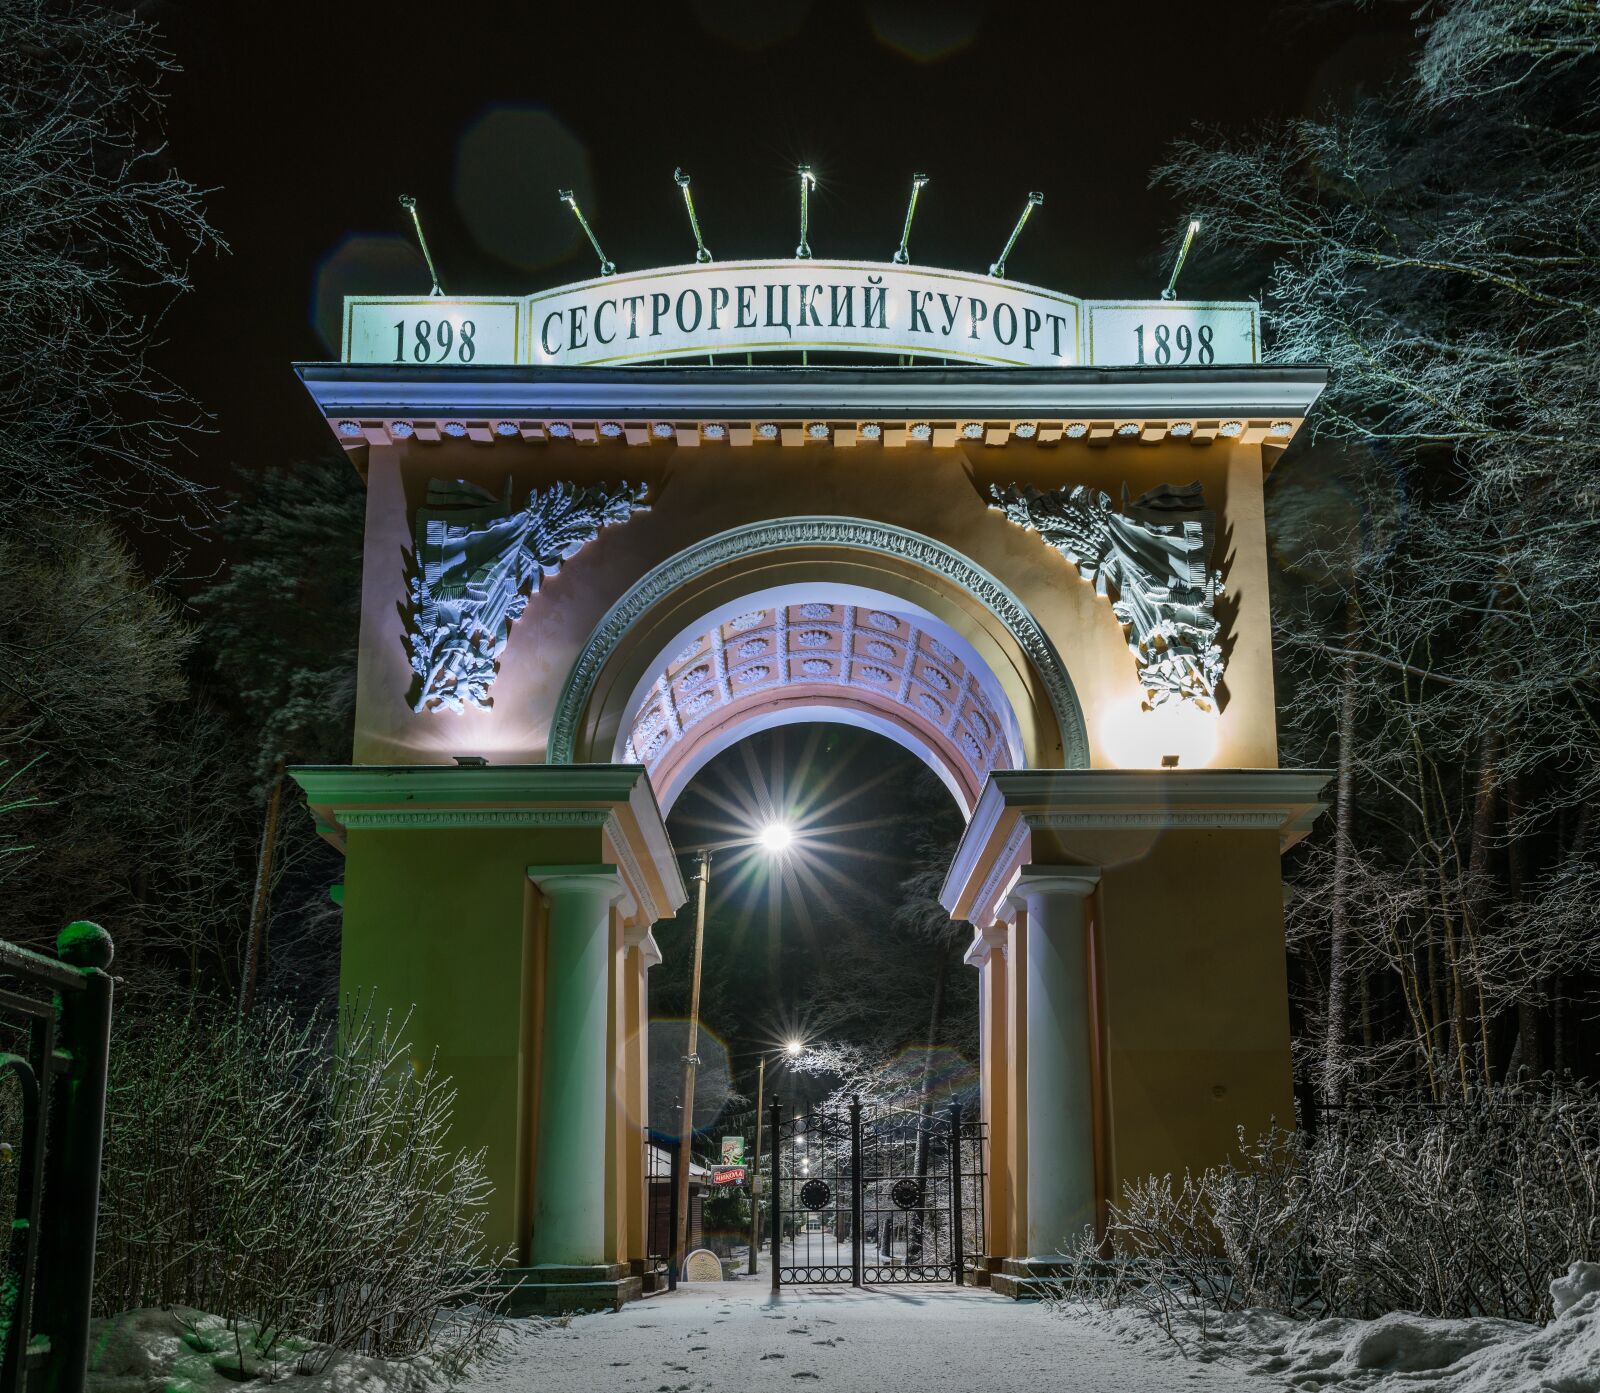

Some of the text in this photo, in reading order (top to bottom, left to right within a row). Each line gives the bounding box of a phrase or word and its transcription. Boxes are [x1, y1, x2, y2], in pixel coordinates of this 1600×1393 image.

[541, 275, 1067, 357] СЕСТРОРЕЦКИЙ КУРОРТ
[393, 319, 476, 364] 1898
[1133, 323, 1215, 366] 1898
